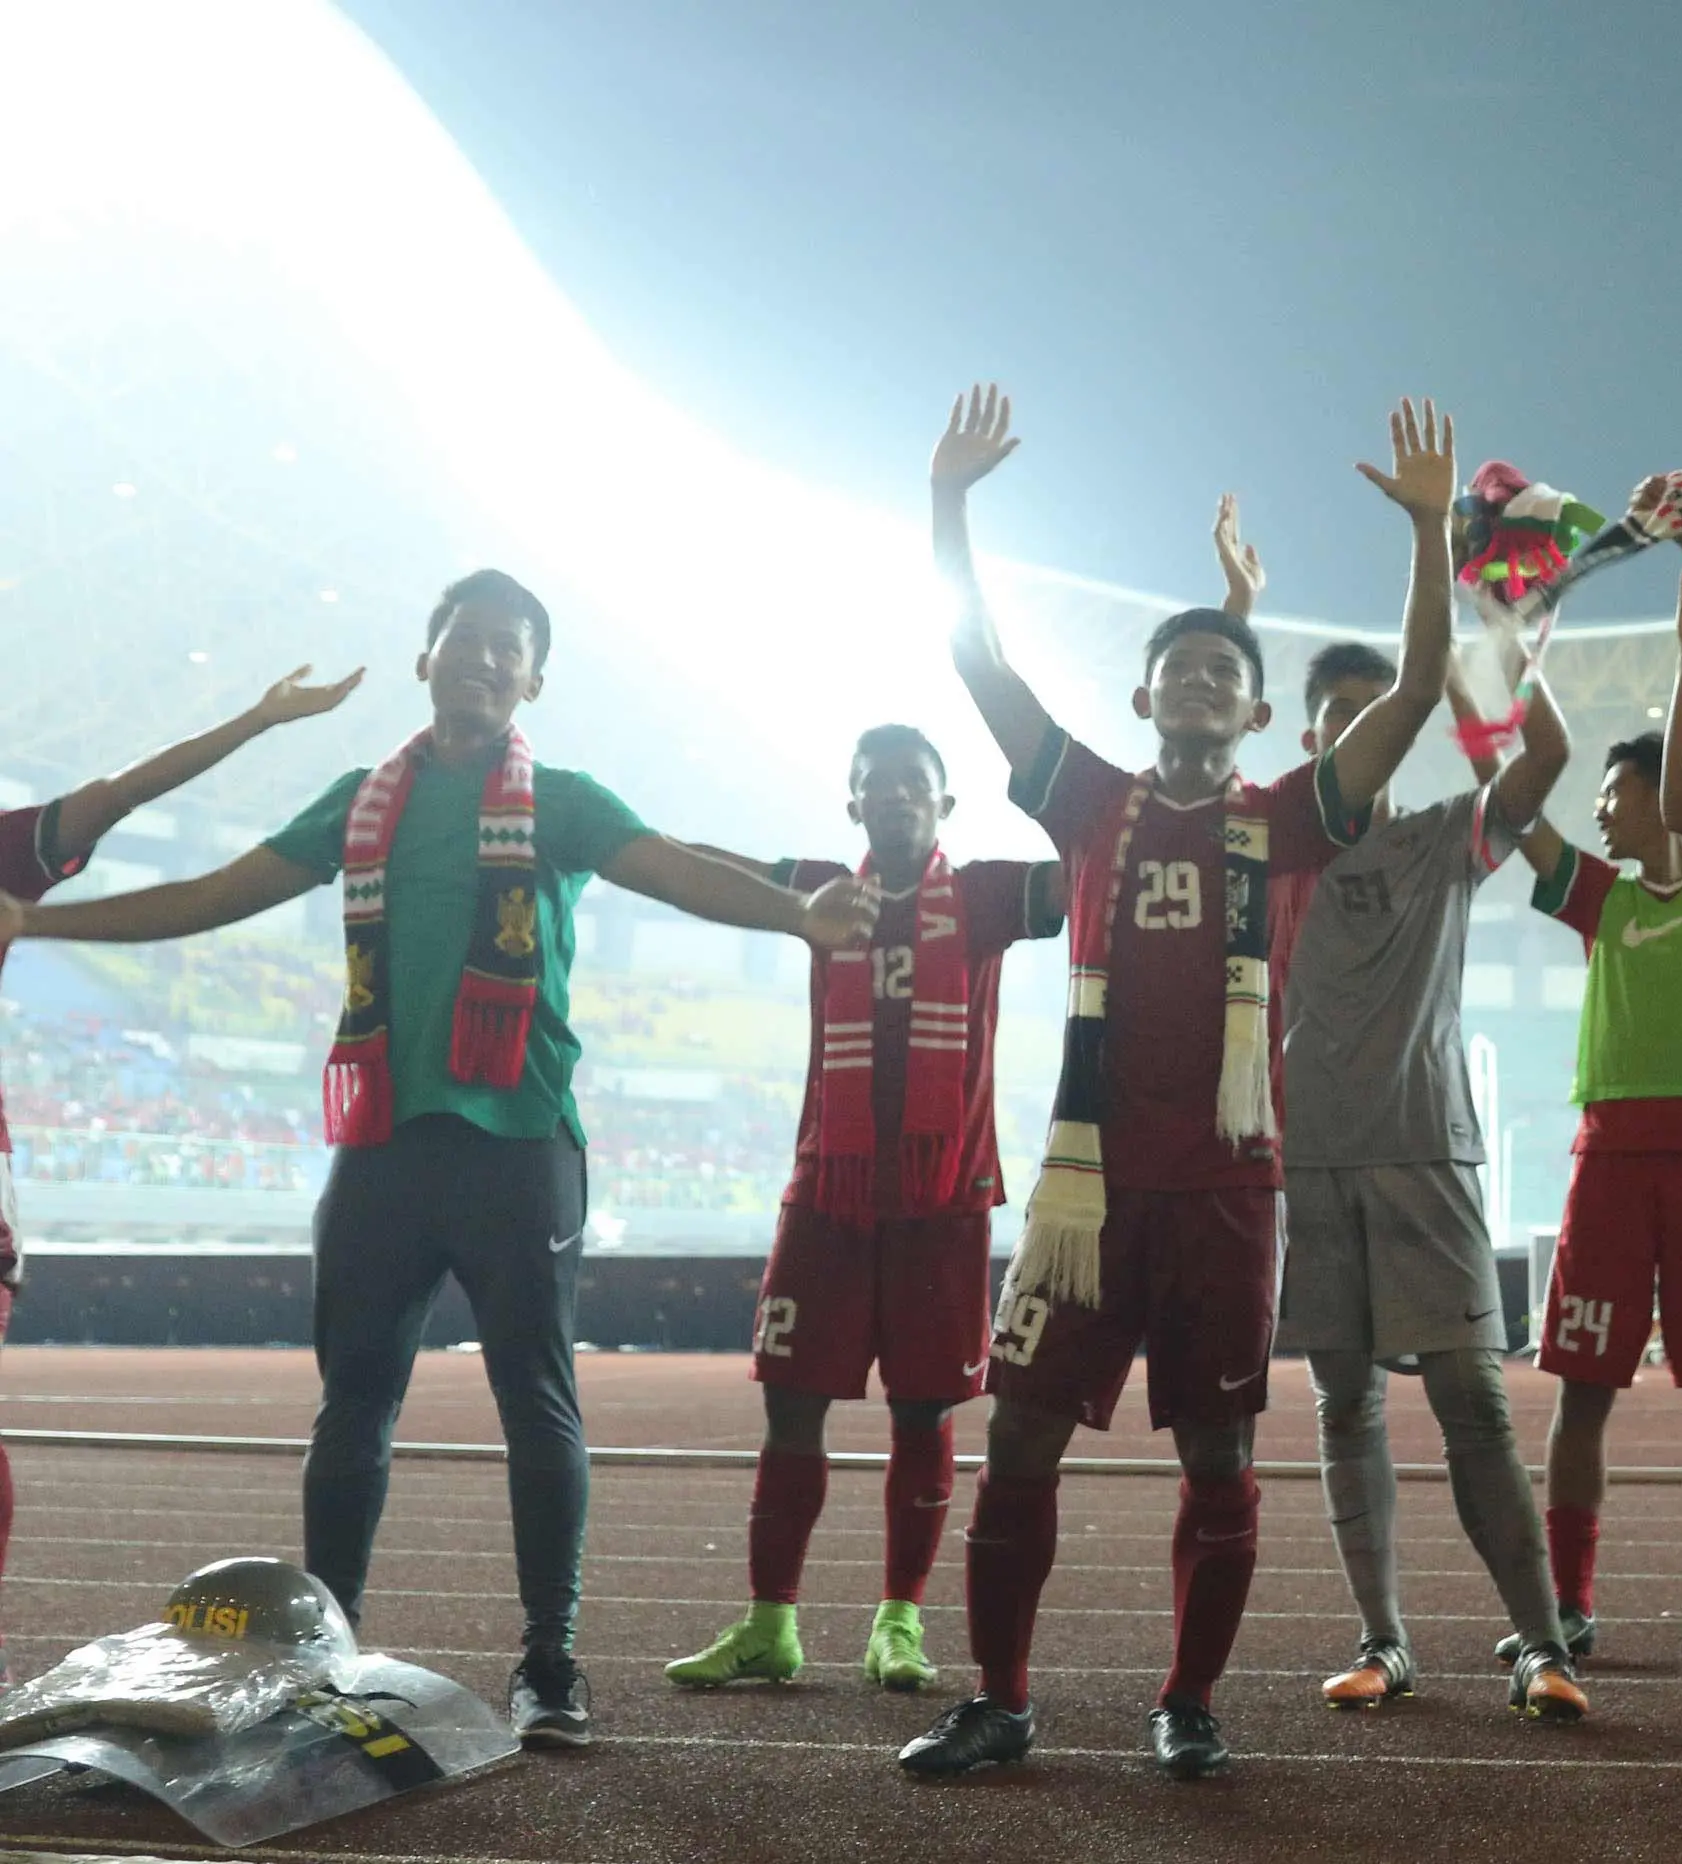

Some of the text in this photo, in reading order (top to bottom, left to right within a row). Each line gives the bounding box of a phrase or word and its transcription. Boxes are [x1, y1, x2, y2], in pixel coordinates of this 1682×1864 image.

[1134, 860, 1203, 929] 29
[870, 945, 915, 999] 12
[753, 1295, 797, 1357] 12
[1556, 1294, 1614, 1355] 24
